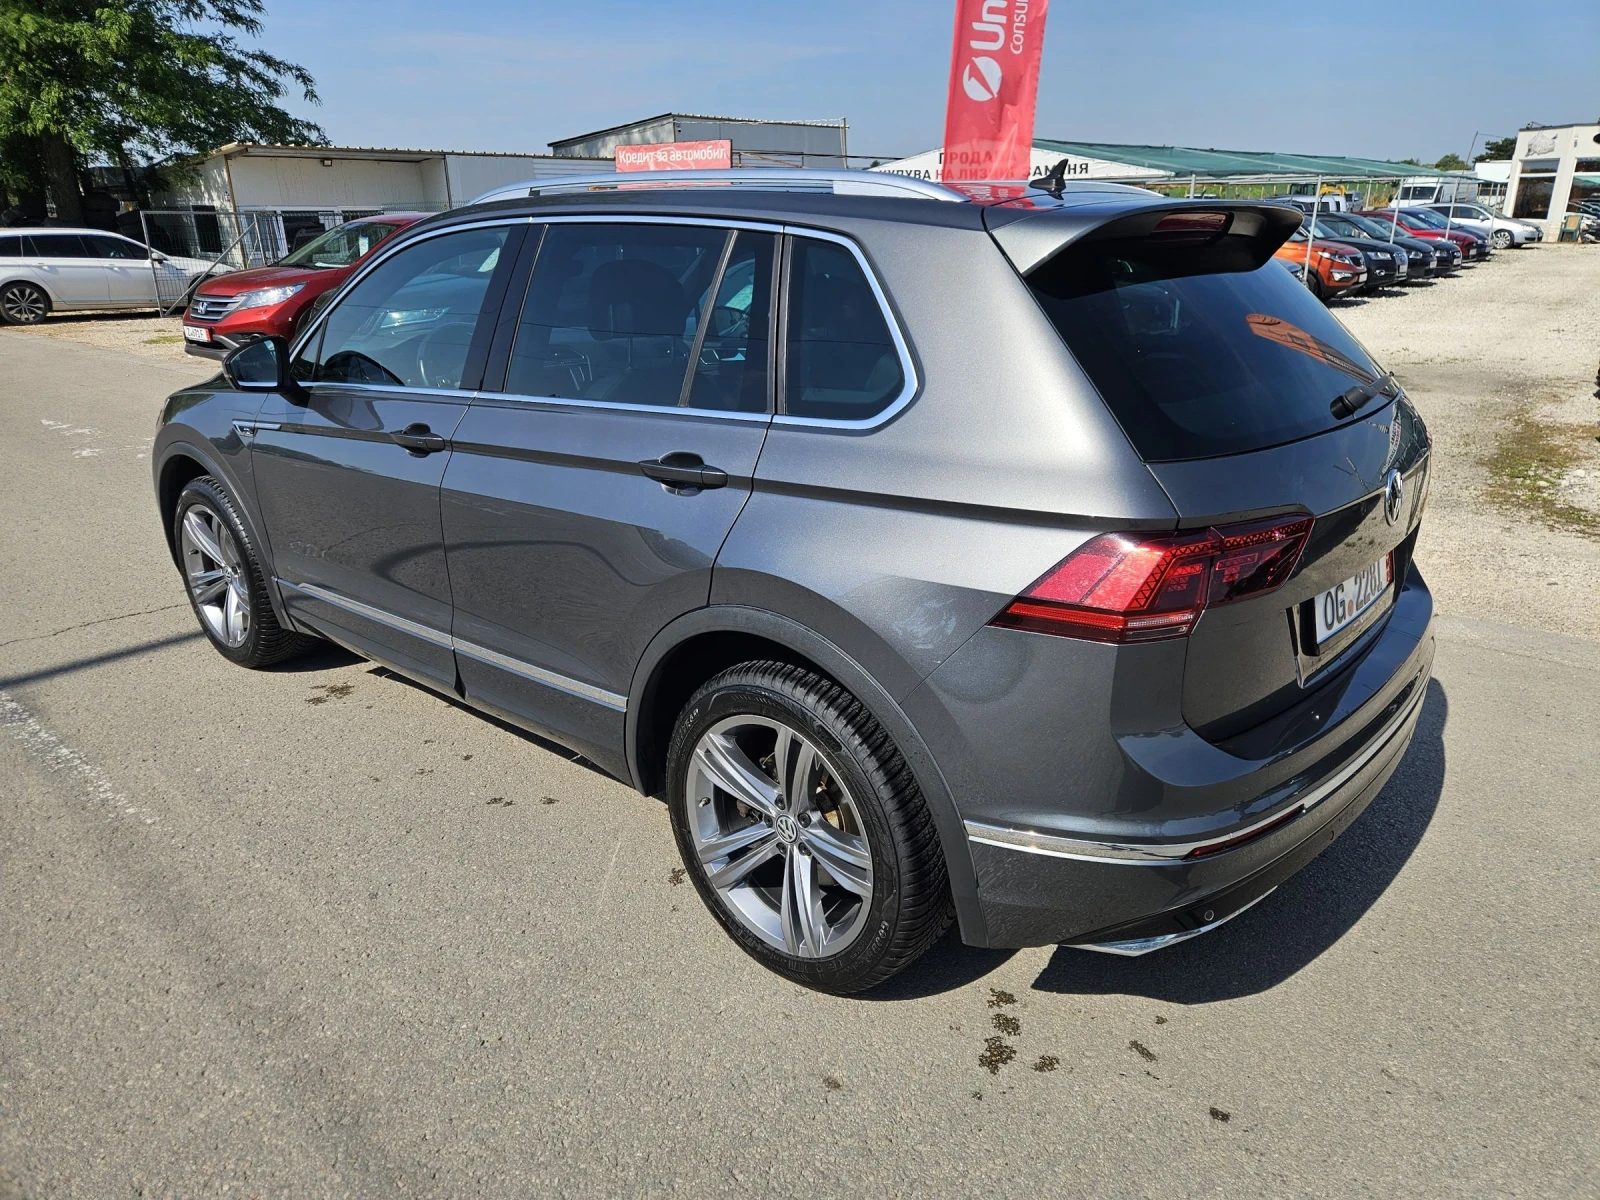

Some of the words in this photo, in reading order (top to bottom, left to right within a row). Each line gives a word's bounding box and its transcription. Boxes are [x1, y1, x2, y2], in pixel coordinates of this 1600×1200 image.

[1010, 0, 1029, 54] Consu
[619, 149, 655, 166] Кредит
[656, 151, 668, 162] за
[669, 145, 727, 161] автомобил
[938, 150, 1018, 166] ПРОДА
[880, 169, 931, 180] ПУВА
[1024, 162, 1089, 178] АМНЯ
[1324, 583, 1347, 631] OG
